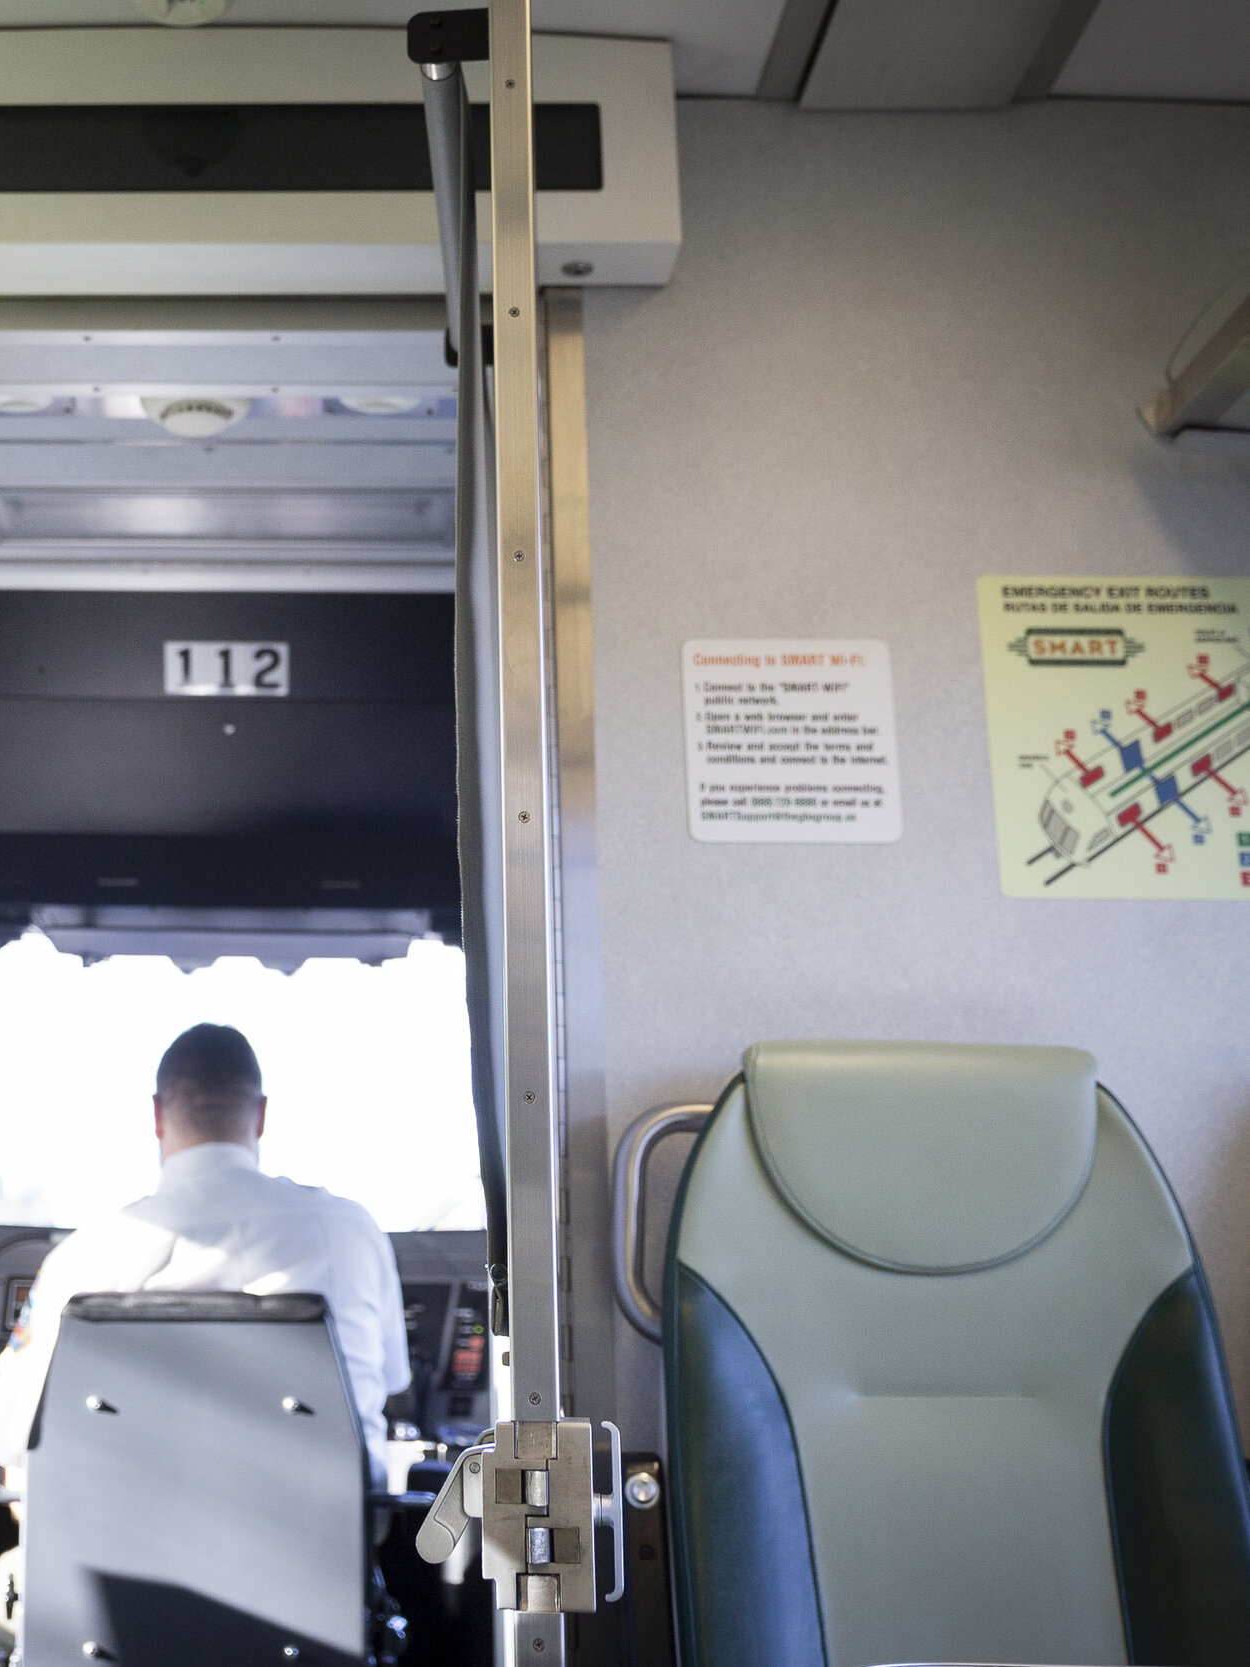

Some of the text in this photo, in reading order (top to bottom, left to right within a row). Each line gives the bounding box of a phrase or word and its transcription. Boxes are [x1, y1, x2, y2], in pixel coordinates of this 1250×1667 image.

[1001, 585, 1211, 600] EMERGENCY EXIT ROUTES
[1003, 602, 1240, 616] RUTAS DE SALIDA DE EMERGENCIA
[1031, 638, 1120, 657] SMART
[692, 653, 762, 669] Connecting
[764, 654, 777, 667] to
[780, 653, 825, 668] SMART
[177, 648, 282, 689] 112
[703, 682, 743, 693] Connect
[745, 683, 756, 692] to
[759, 683, 775, 692] the
[811, 713, 829, 722] and
[746, 742, 764, 752] and
[855, 742, 874, 752] and
[759, 755, 777, 765] and
